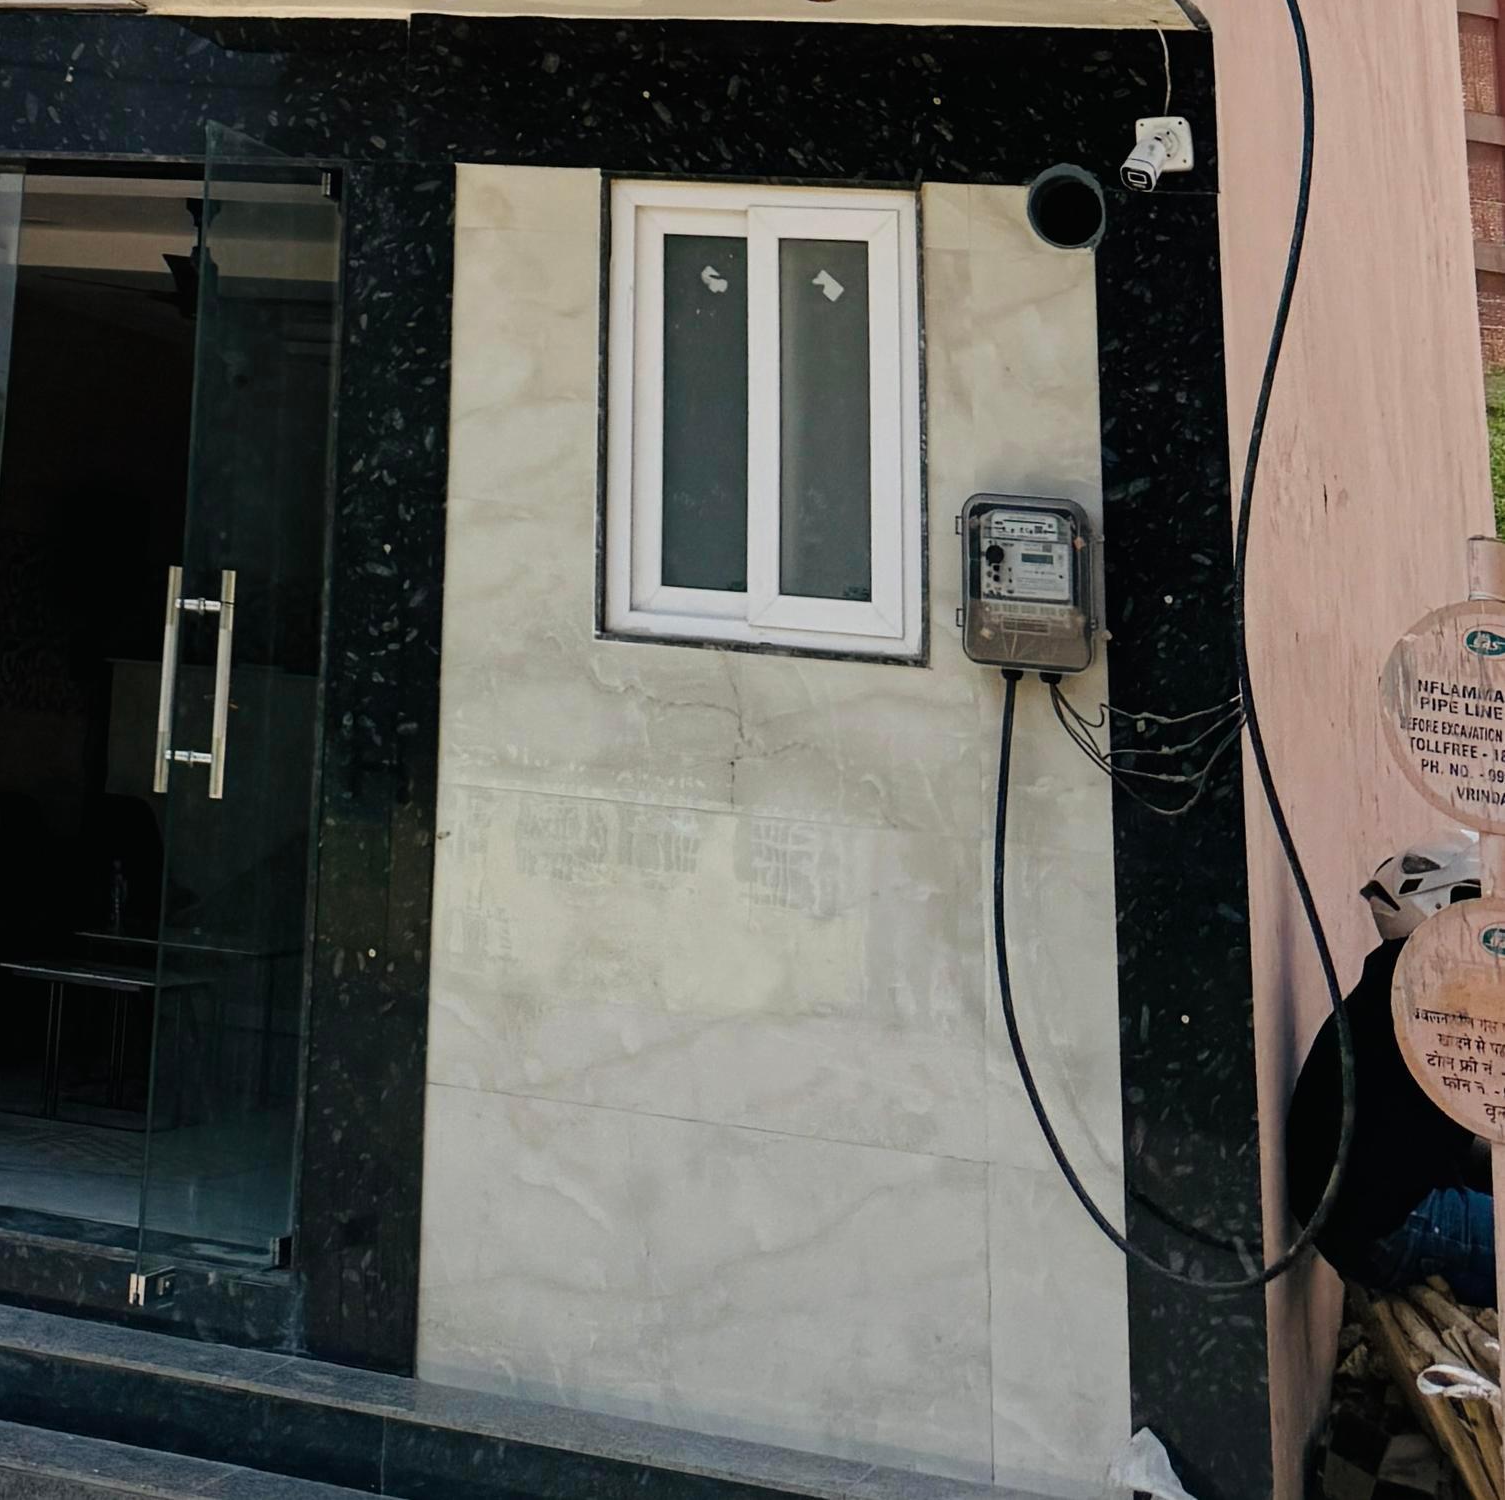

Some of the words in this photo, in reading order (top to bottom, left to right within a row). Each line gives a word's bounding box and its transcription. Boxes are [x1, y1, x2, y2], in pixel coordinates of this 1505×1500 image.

[1420, 697, 1459, 714] PIPE
[1465, 703, 1503, 720] LINE
[1410, 737, 1478, 759] TOLLFREE
